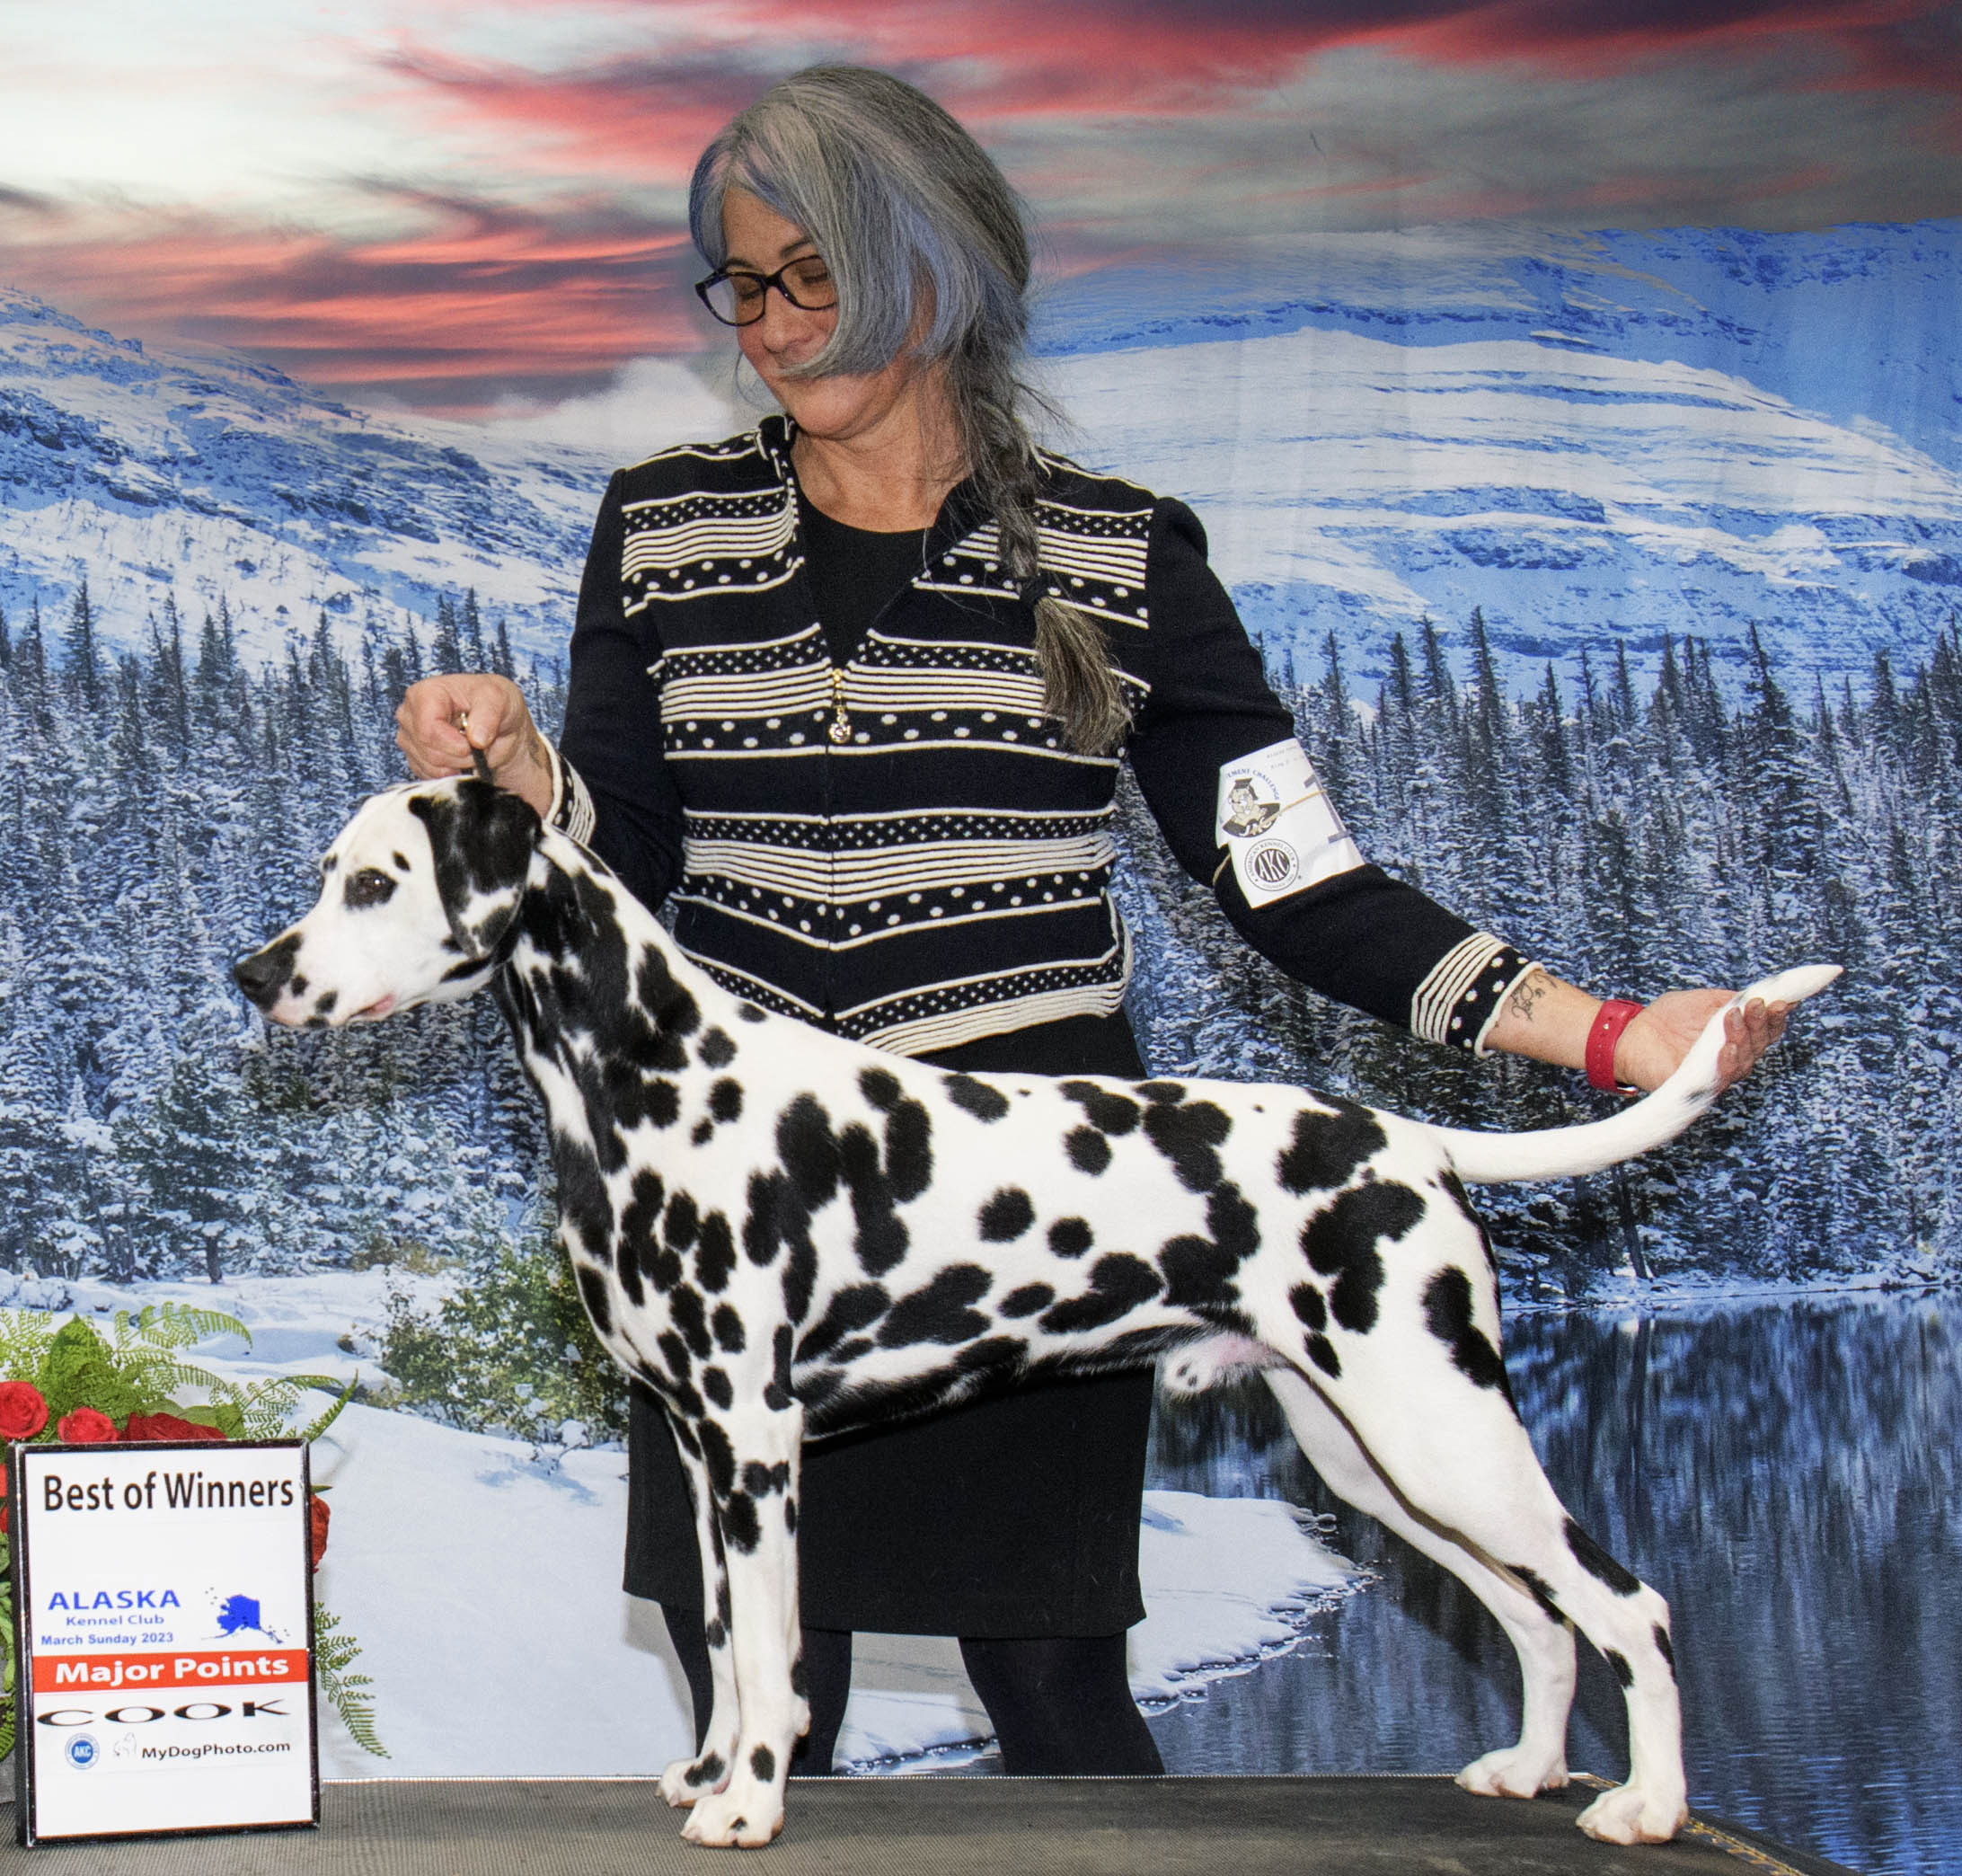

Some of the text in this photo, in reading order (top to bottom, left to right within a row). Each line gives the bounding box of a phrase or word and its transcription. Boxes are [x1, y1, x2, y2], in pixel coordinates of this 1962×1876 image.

[1258, 849, 1289, 881] AKC
[44, 1472, 293, 1511] Best of Winners
[49, 1590, 180, 1610] ALASKA
[66, 1615, 164, 1625] Kennel Club
[41, 1633, 172, 1645] March Sunday 2023
[56, 1656, 288, 1687] Major Points
[37, 1700, 287, 1726] COOK
[74, 1744, 92, 1758] AKC
[143, 1744, 289, 1760] MyDogPhoto.com
